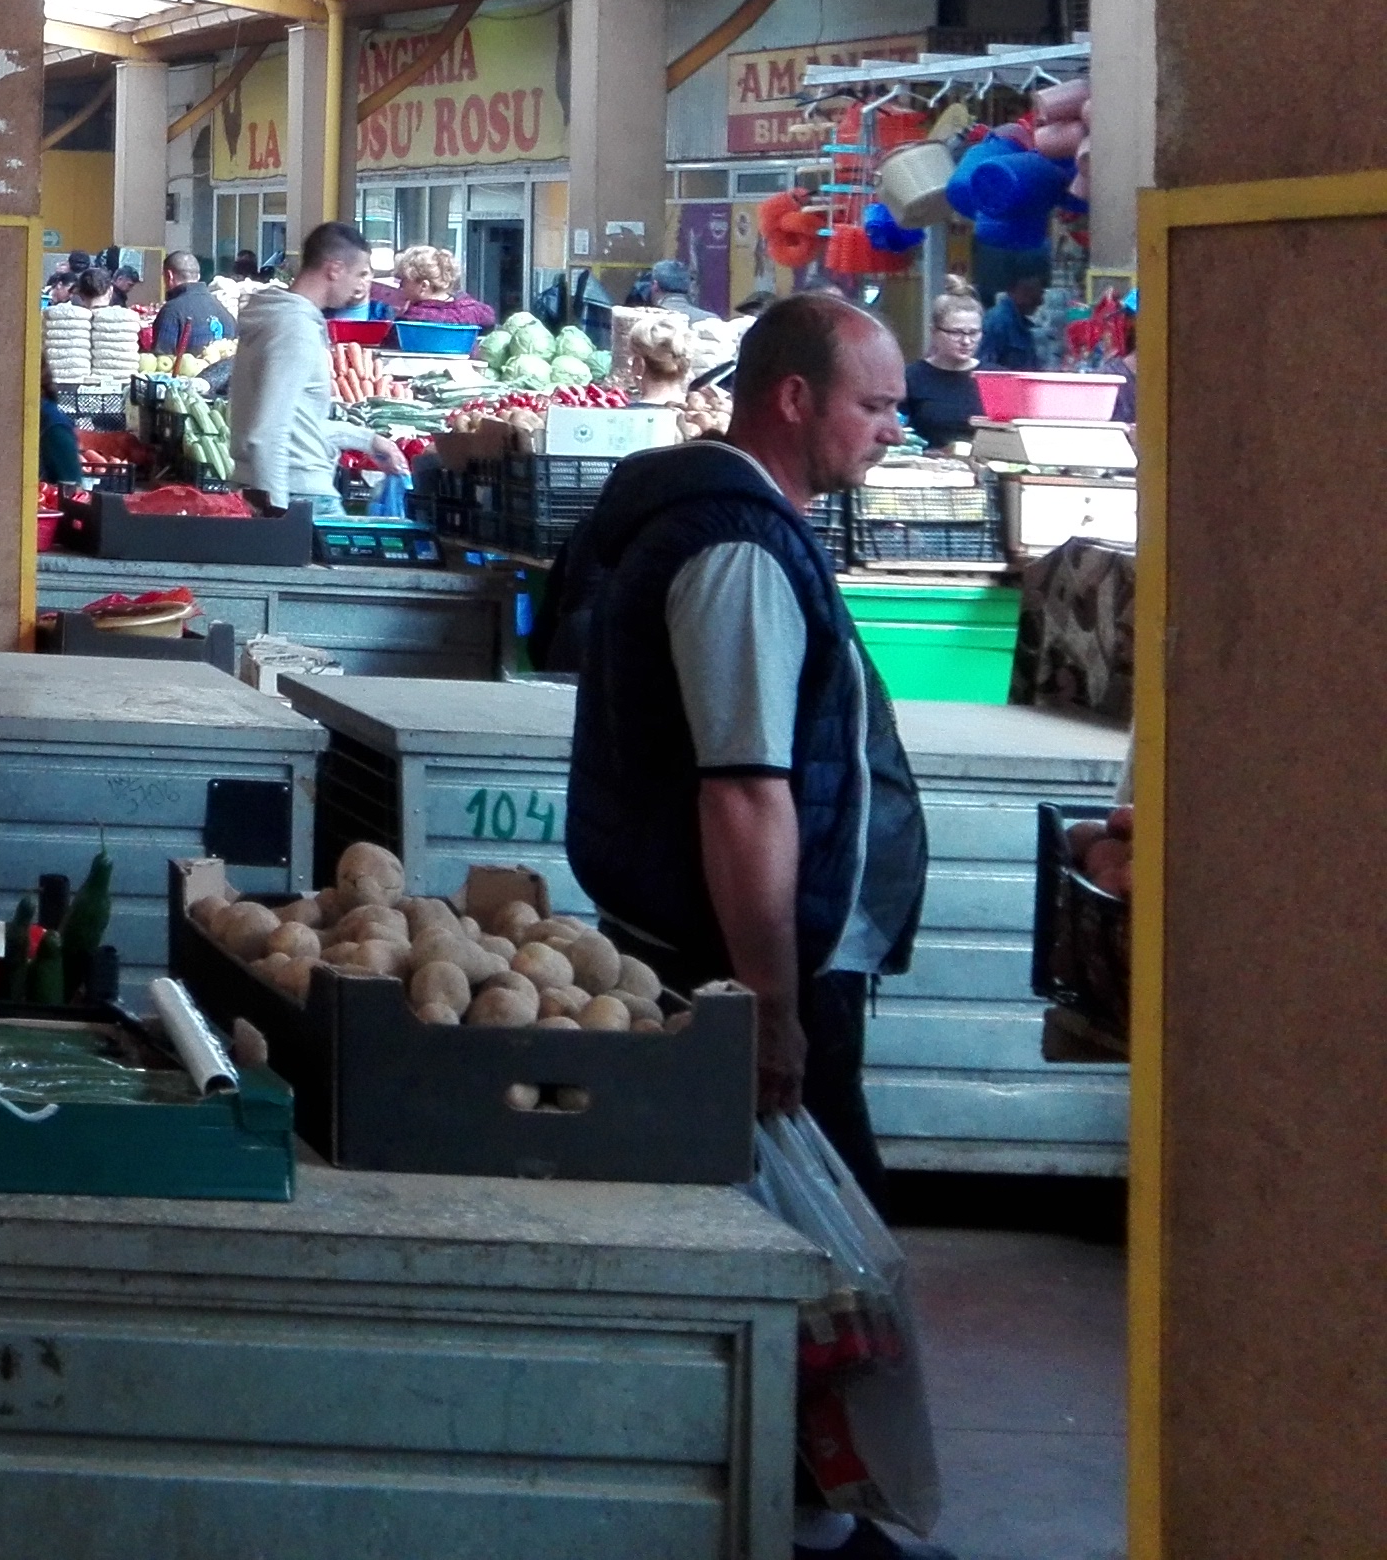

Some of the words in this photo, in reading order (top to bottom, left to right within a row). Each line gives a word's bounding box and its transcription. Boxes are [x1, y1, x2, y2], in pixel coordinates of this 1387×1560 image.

[247, 119, 281, 171] LA
[434, 87, 544, 157] ROSU
[466, 788, 555, 842] 104
